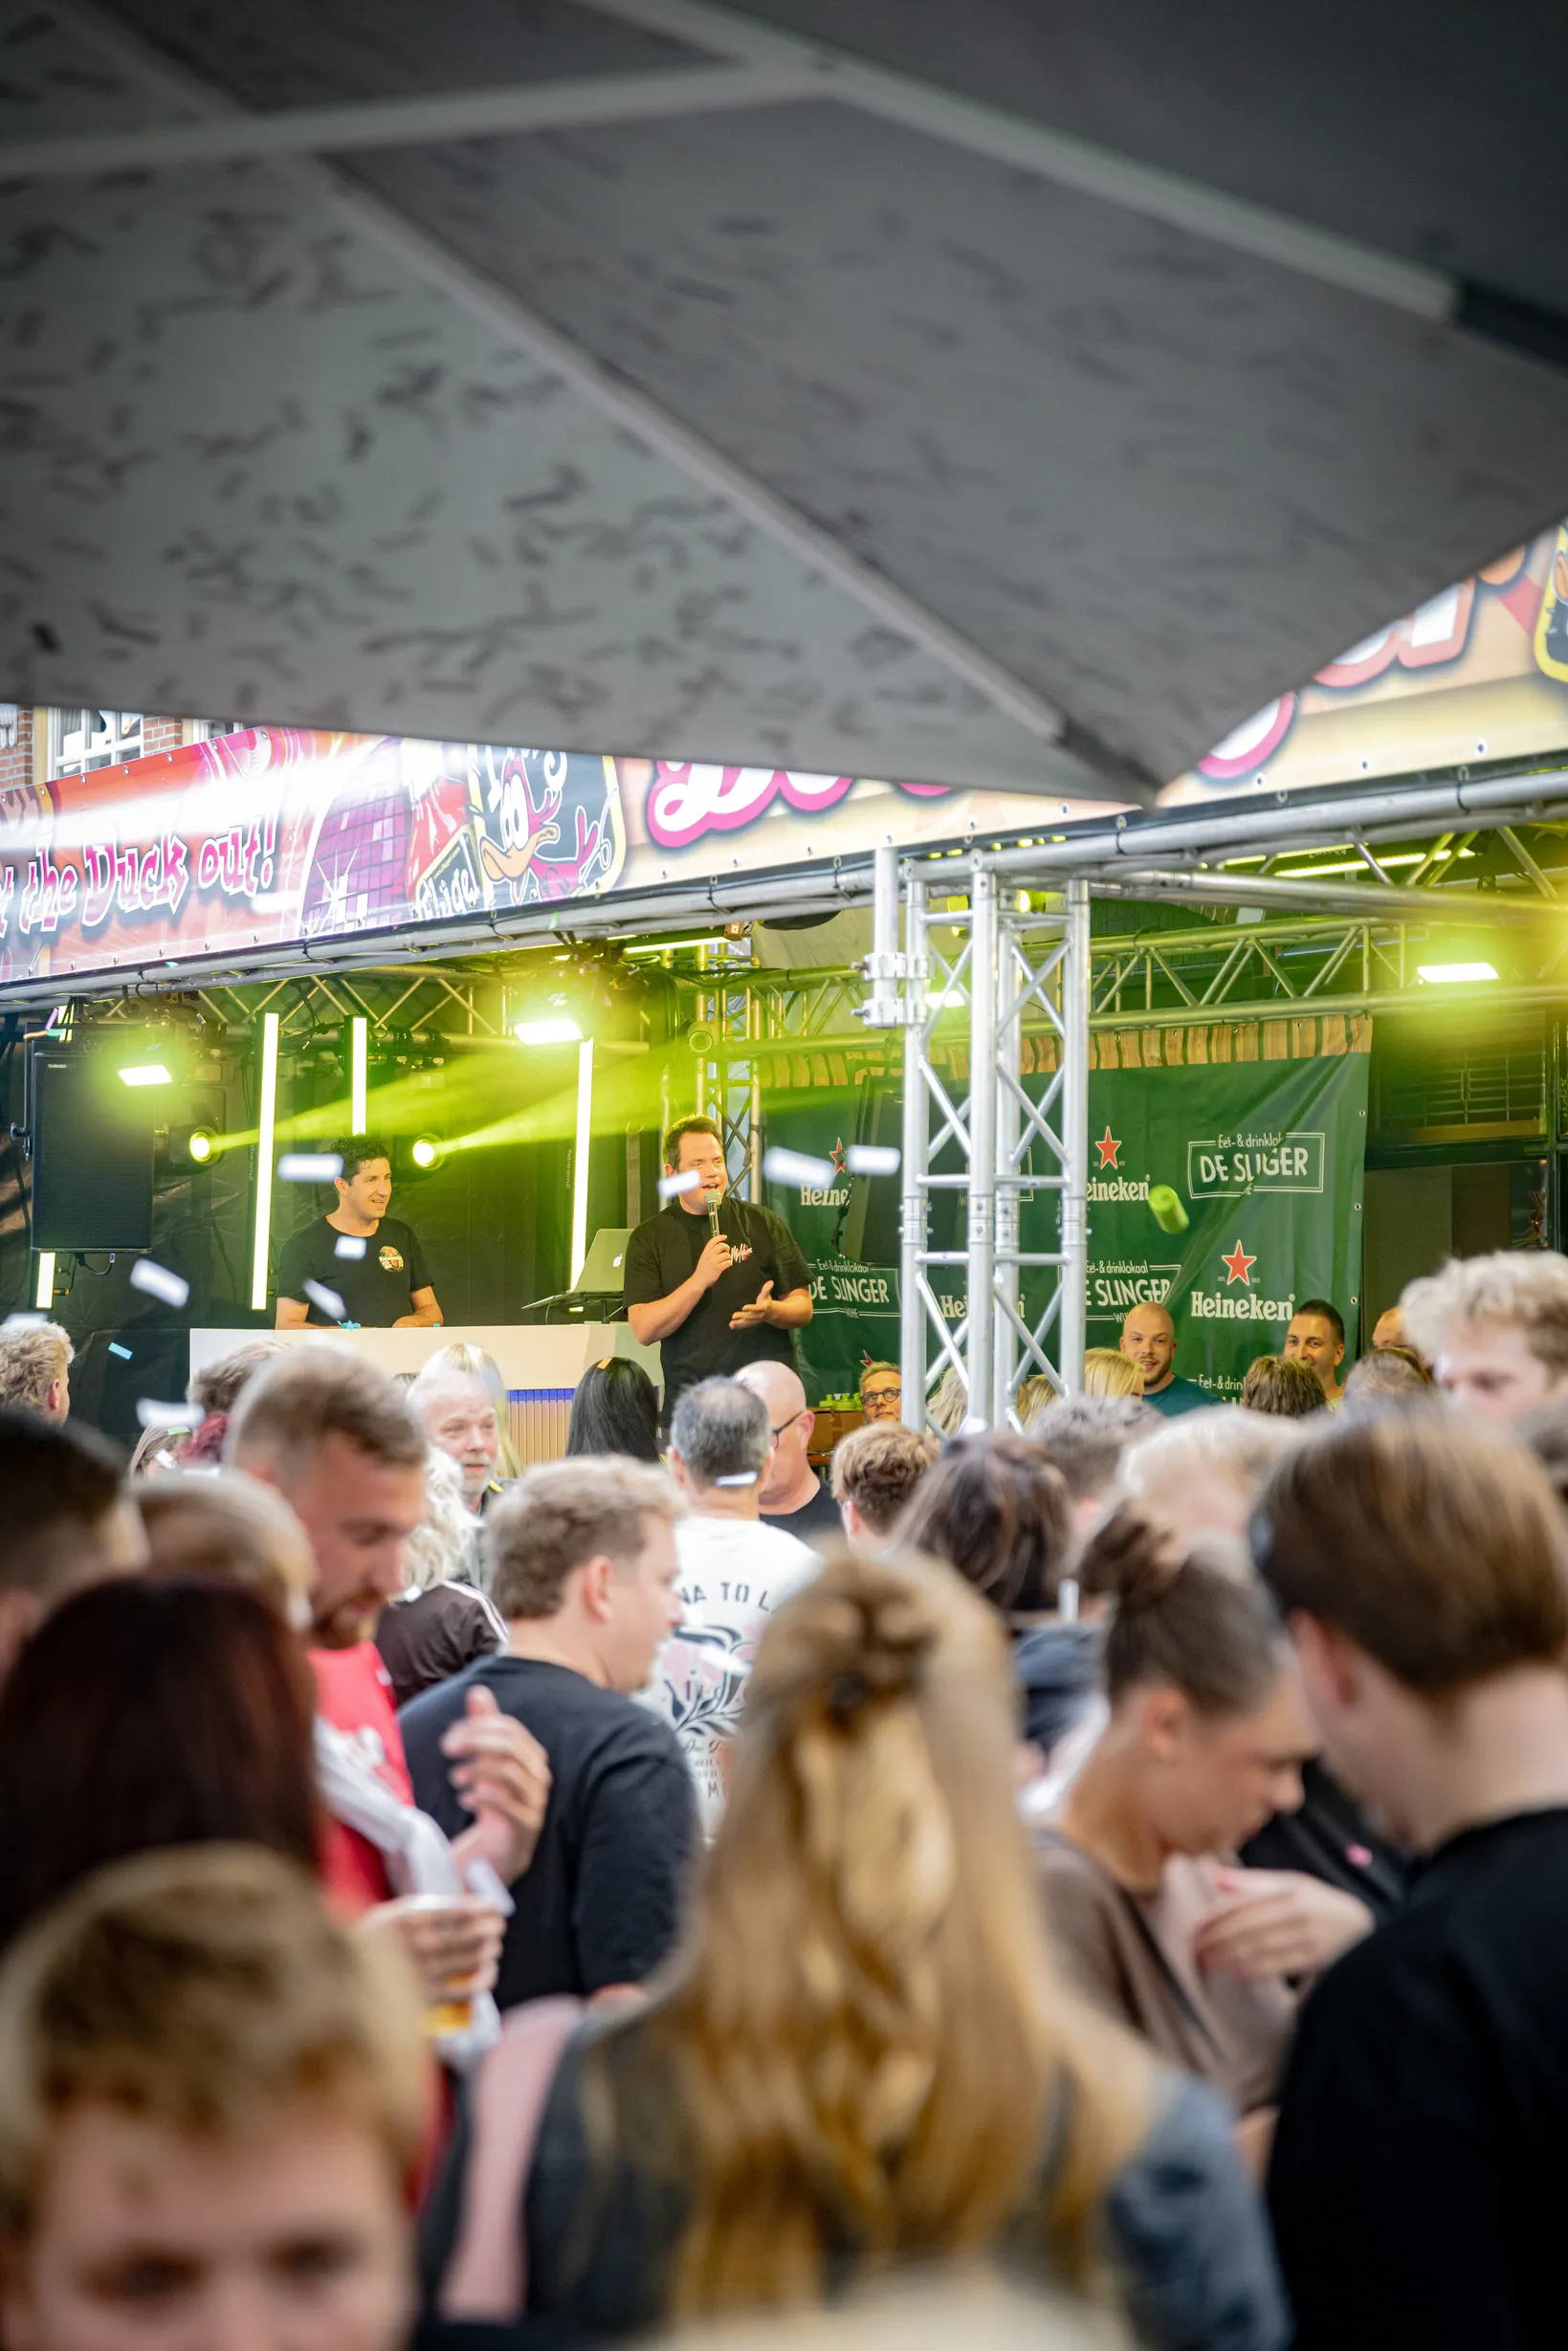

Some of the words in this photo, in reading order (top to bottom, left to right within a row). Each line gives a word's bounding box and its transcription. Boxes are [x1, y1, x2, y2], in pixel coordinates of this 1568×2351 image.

[19, 832, 78, 935] the
[82, 819, 189, 927] Duck
[198, 815, 277, 898] out!
[1200, 1155, 1229, 1183] DE
[800, 1184, 850, 1206] Heine
[1086, 1175, 1150, 1202] eineken
[1106, 1260, 1148, 1274] drinklokaal
[830, 1275, 891, 1303] SLINGER
[1191, 1291, 1293, 1321] Heineken
